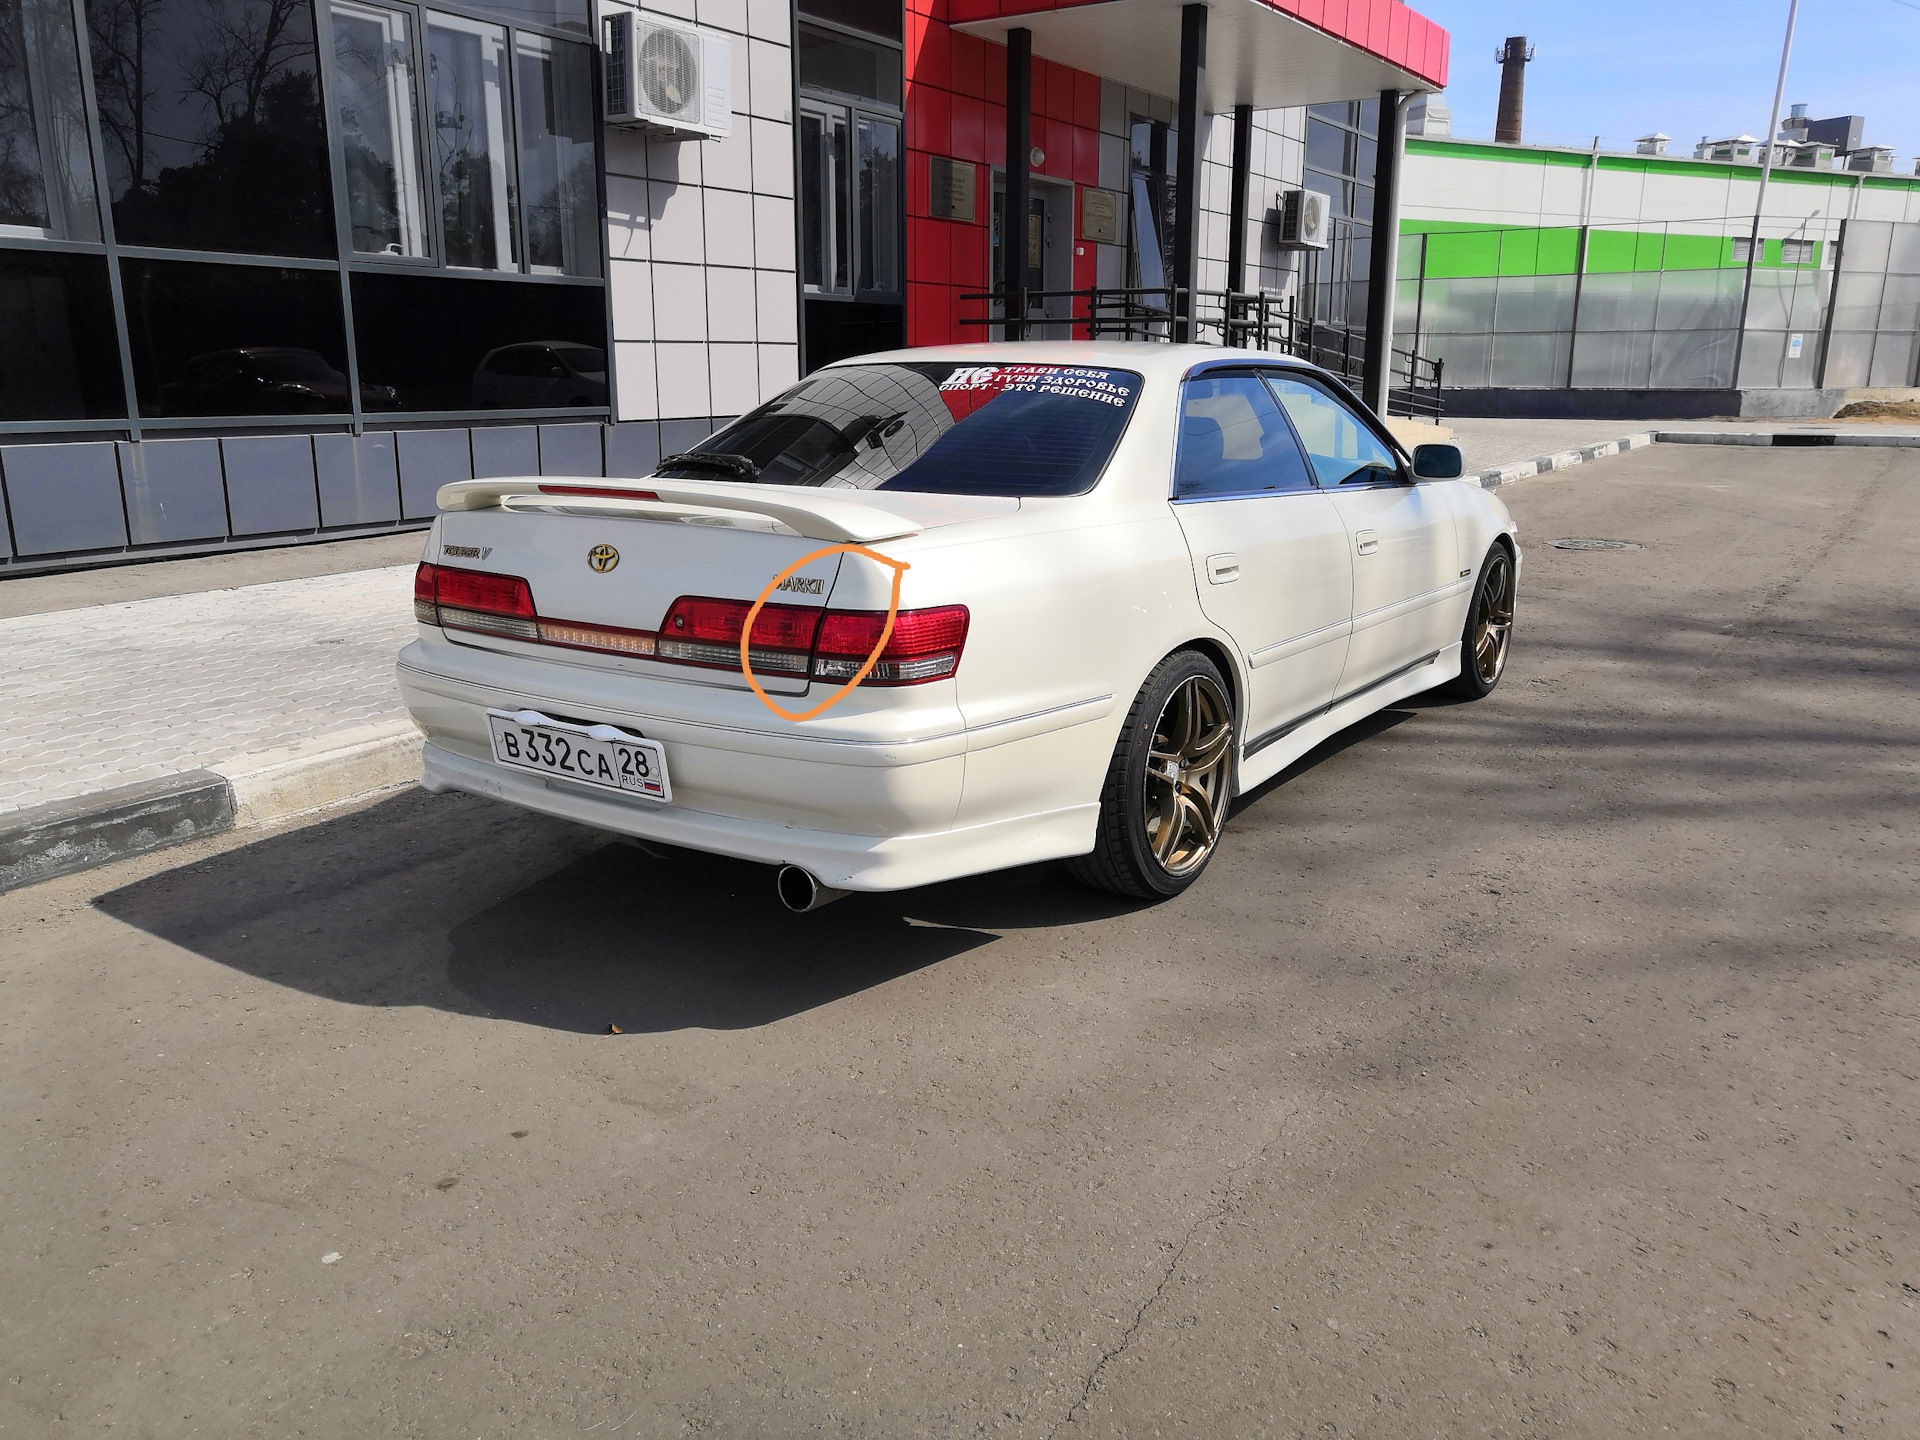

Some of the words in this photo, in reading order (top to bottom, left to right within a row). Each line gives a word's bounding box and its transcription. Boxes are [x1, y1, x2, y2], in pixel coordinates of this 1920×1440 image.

[939, 382, 993, 391] СПОРТ
[1001, 383, 1036, 392] ЭТО
[1038, 385, 1126, 407] РЕШЕНИЕ
[1040, 375, 1131, 397] ЗДОРОВЬЕ
[618, 747, 650, 778] 28
[621, 774, 644, 788] RUS
